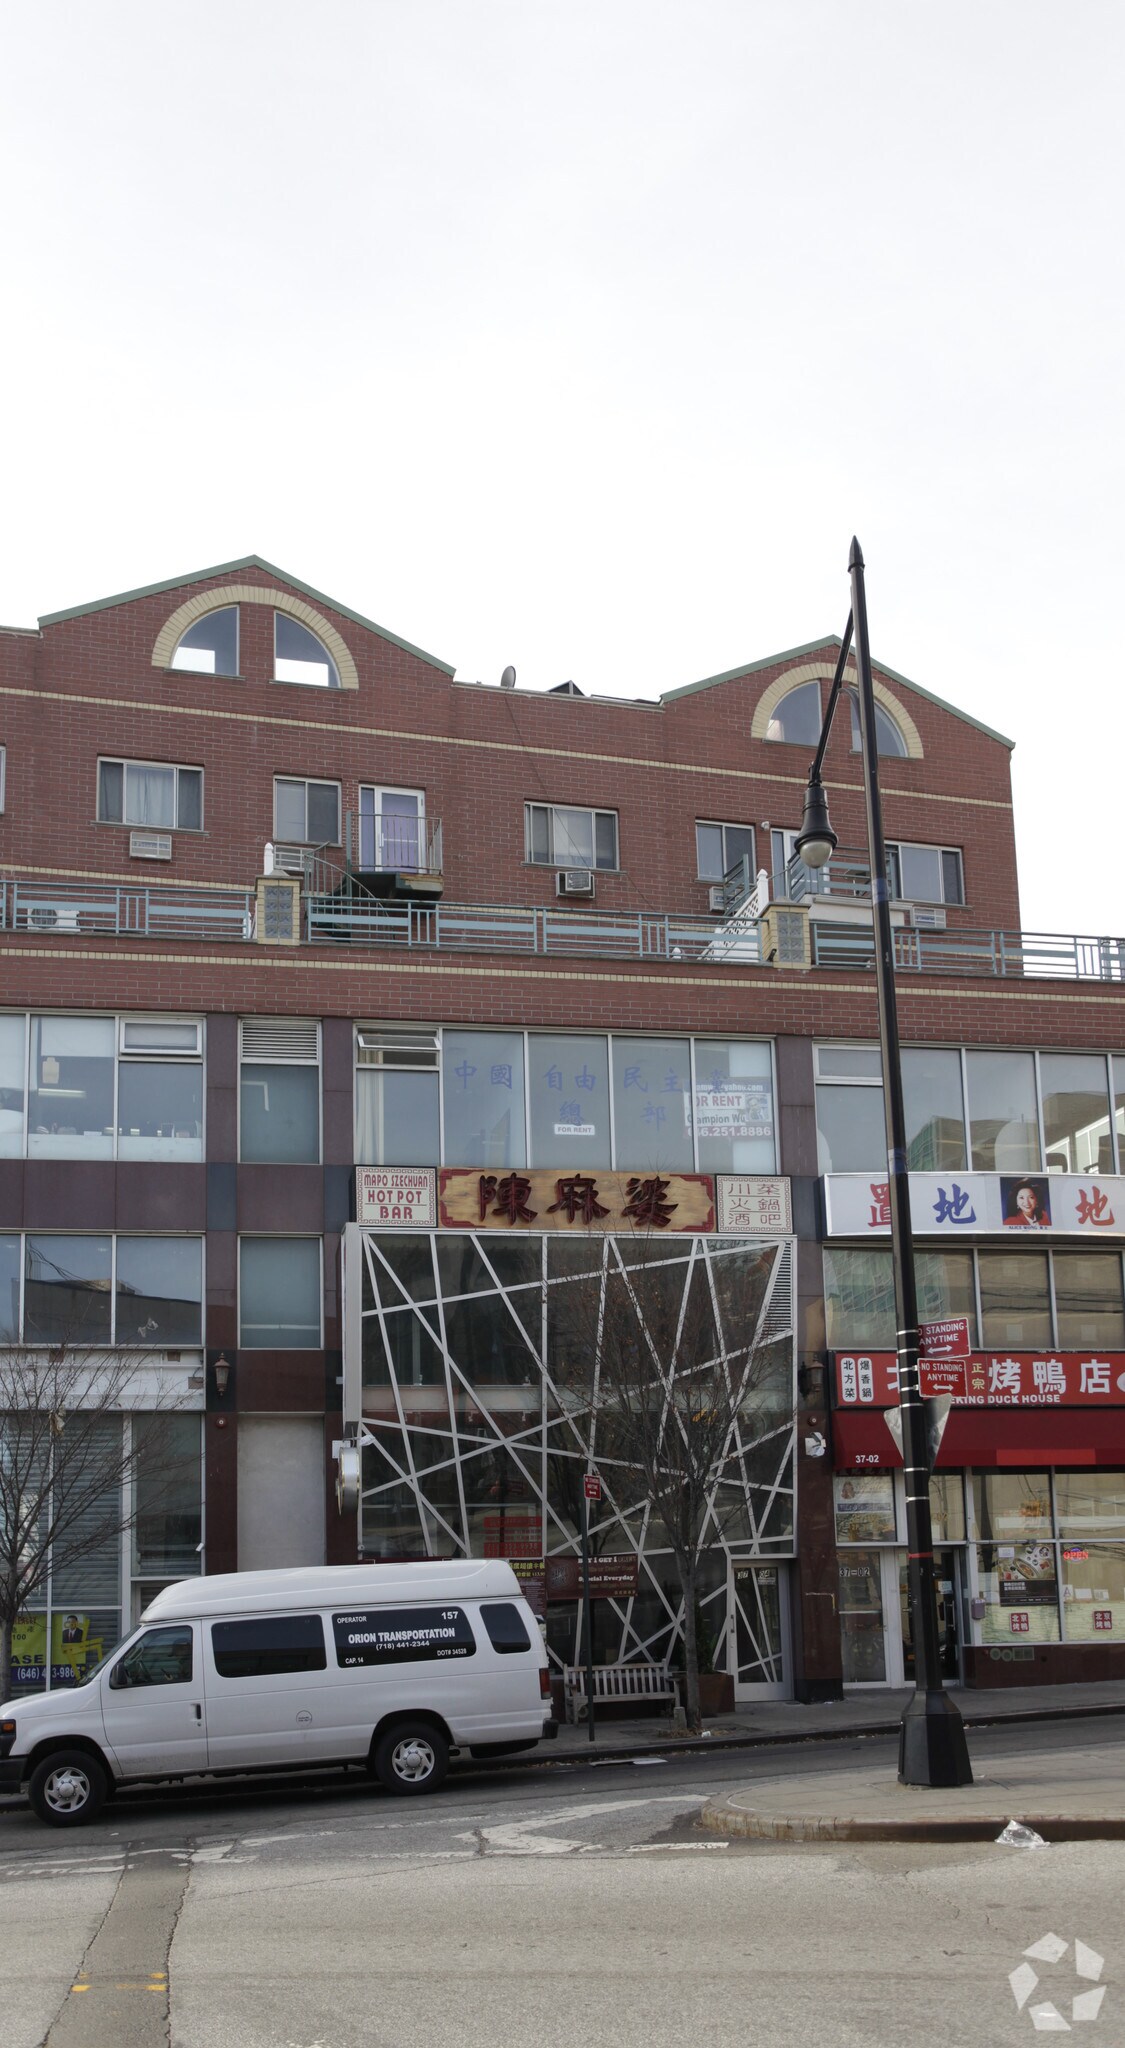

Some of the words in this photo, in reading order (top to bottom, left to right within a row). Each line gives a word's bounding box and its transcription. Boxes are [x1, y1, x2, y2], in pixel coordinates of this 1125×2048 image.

[712, 1096, 742, 1106] RENT
[687, 1114, 729, 1125] Campion
[732, 1114, 746, 1122] Wu
[364, 1174, 388, 1187] MAPO
[391, 1175, 428, 1187] SZECHUAN
[368, 1190, 393, 1203] HOT
[397, 1191, 422, 1203] POT
[480, 1172, 678, 1228] 陳麻婆
[729, 1198, 780, 1211] 火鍋
[380, 1206, 413, 1219] BAR
[728, 1213, 782, 1226] 酒吧
[926, 1322, 964, 1335] STANDING
[919, 1333, 959, 1345] ANYTIME
[921, 1362, 931, 1371] NO
[932, 1363, 963, 1372] STANDING
[843, 1360, 857, 1398] 北方菜
[927, 1373, 959, 1382] ANYTIME
[988, 1358, 1111, 1394] 烤鴨店
[950, 1395, 985, 1405] EKING
[988, 1395, 1019, 1404] DUCK
[1022, 1394, 1061, 1403] HOUSE
[855, 1454, 879, 1463] 37-02
[1063, 1551, 1089, 1560] OPEN
[603, 1574, 634, 1582] Everyday
[337, 1616, 367, 1624] OPERATOR
[441, 1611, 458, 1620] 157
[348, 1633, 376, 1644] ORION
[378, 1628, 456, 1642] TRANSPORTATION
[376, 1643, 394, 1651] (718)
[396, 1640, 430, 1648] 441-2344
[18, 1668, 40, 1680] (646)
